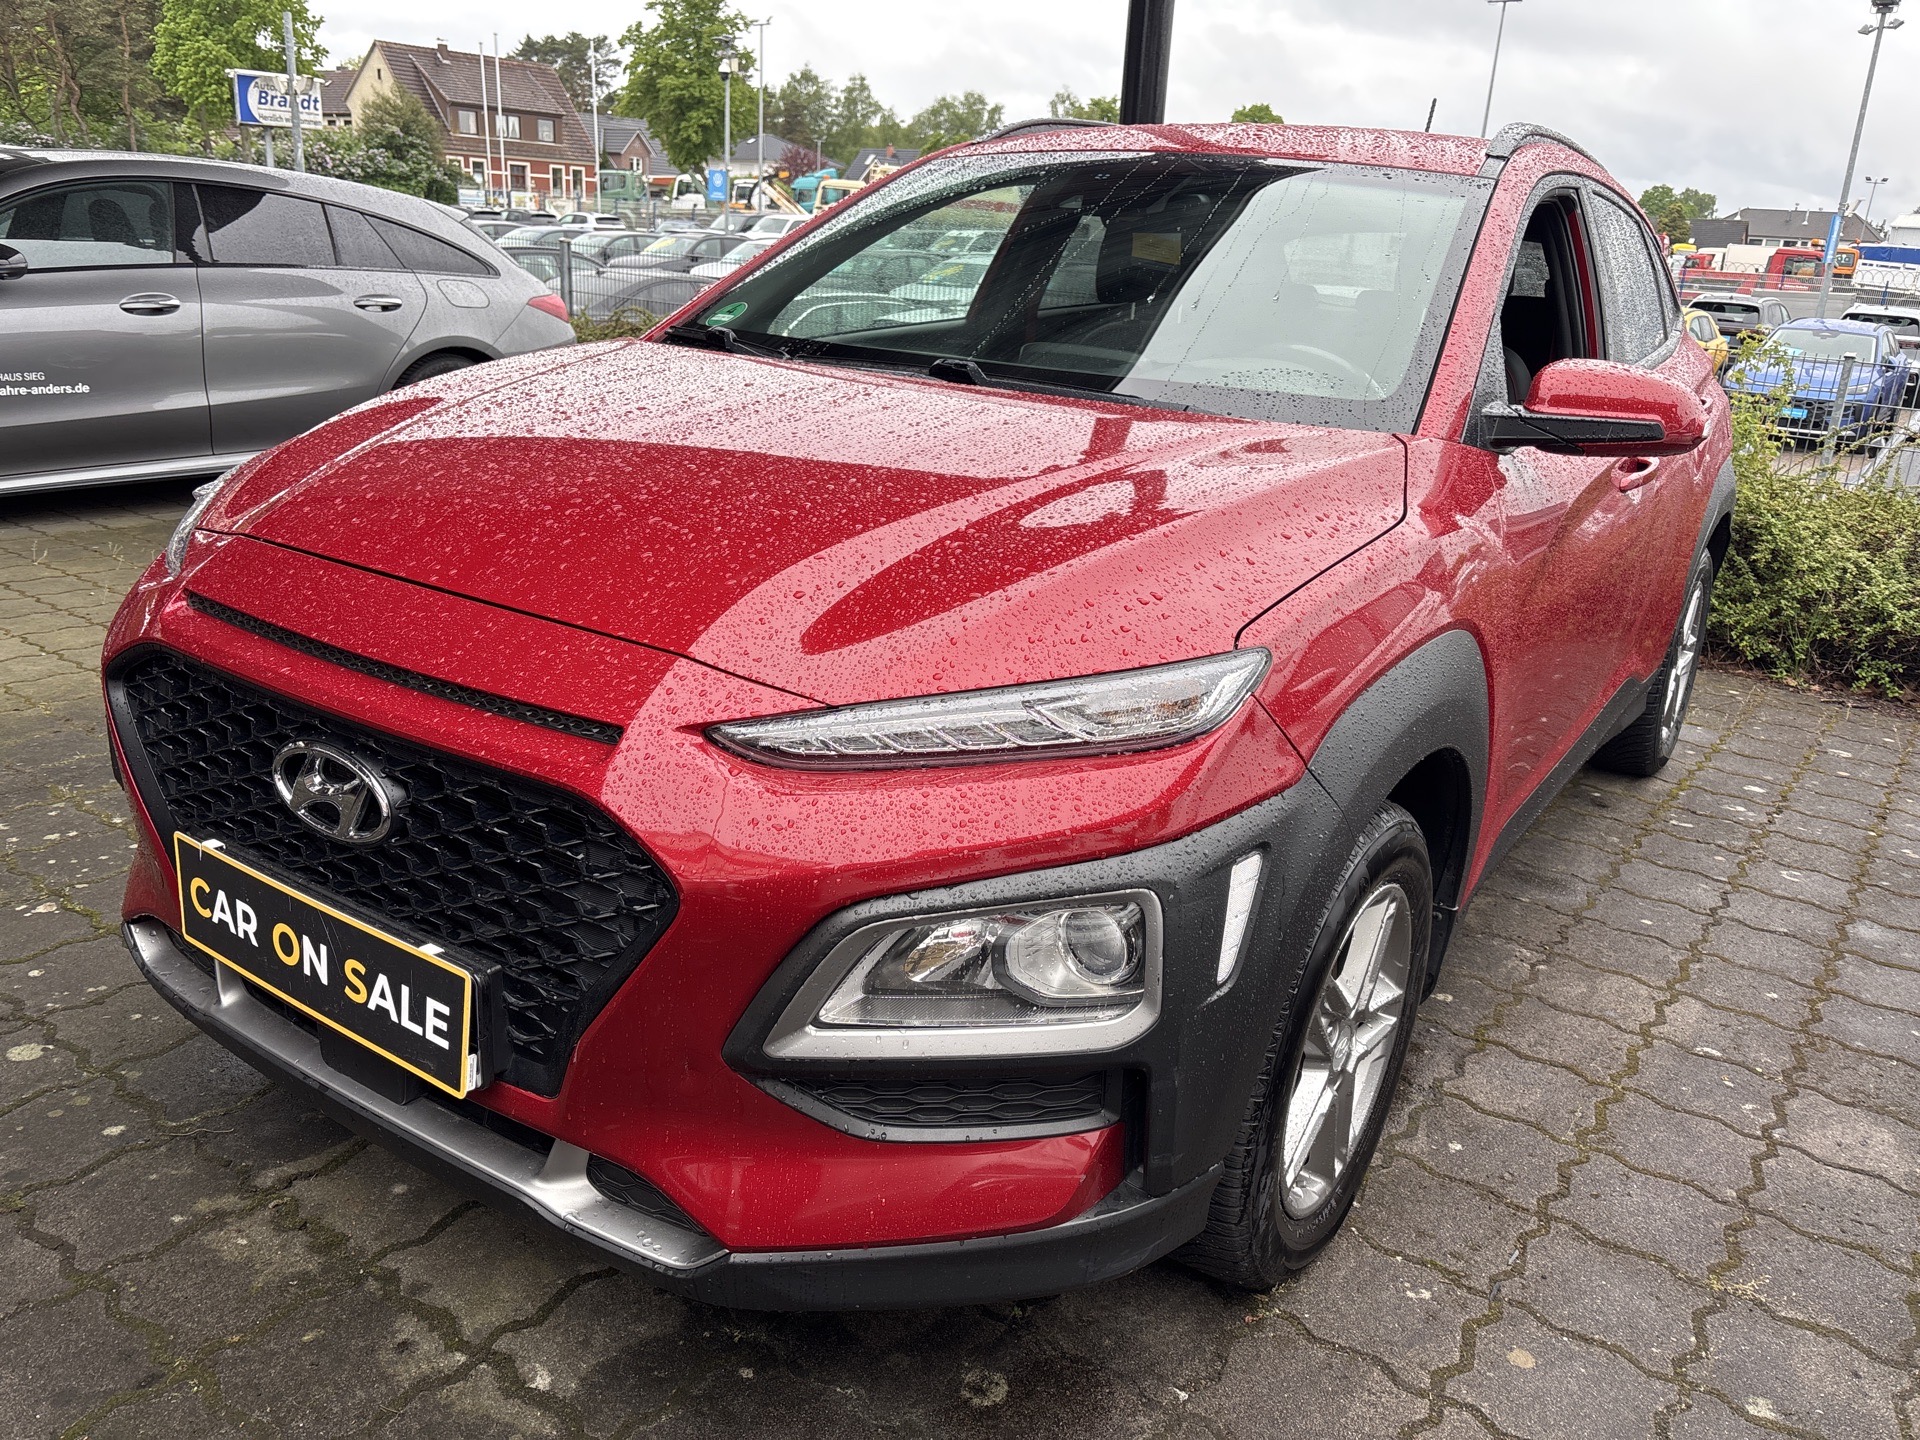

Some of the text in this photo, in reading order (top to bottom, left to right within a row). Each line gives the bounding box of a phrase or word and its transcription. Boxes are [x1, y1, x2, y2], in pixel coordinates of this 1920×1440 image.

[258, 90, 320, 111] Bradt
[24, 371, 46, 381] SIEG
[0, 383, 90, 396] ahre-anders.de
[190, 876, 451, 1050] CAR ON SALE
